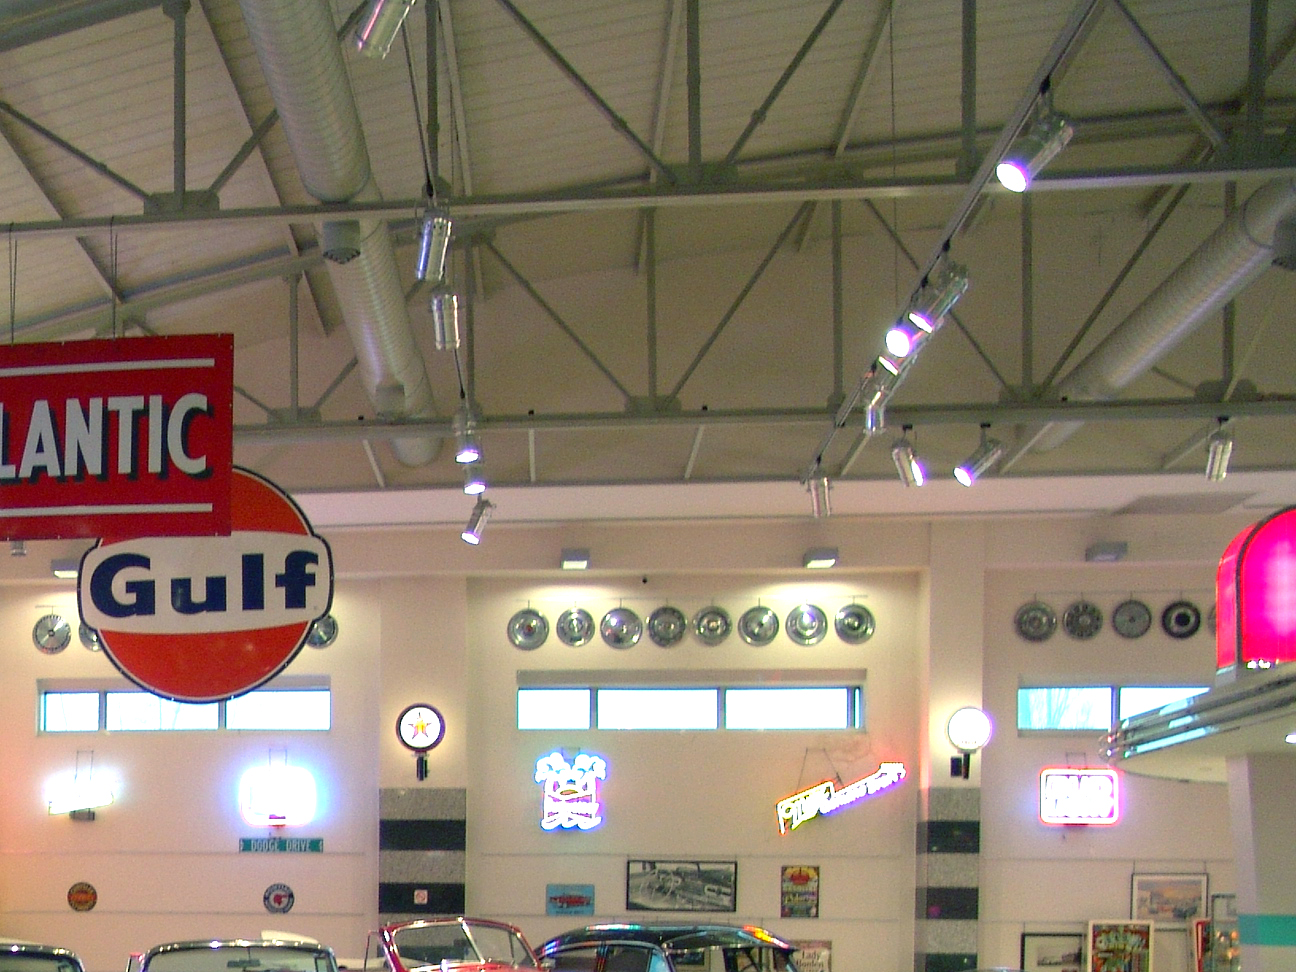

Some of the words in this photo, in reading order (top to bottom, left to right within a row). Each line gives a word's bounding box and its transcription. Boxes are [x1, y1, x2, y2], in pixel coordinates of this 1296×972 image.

[89, 548, 320, 620] Gulf
[250, 839, 279, 852] DODGE
[285, 839, 311, 852] DRIVE
